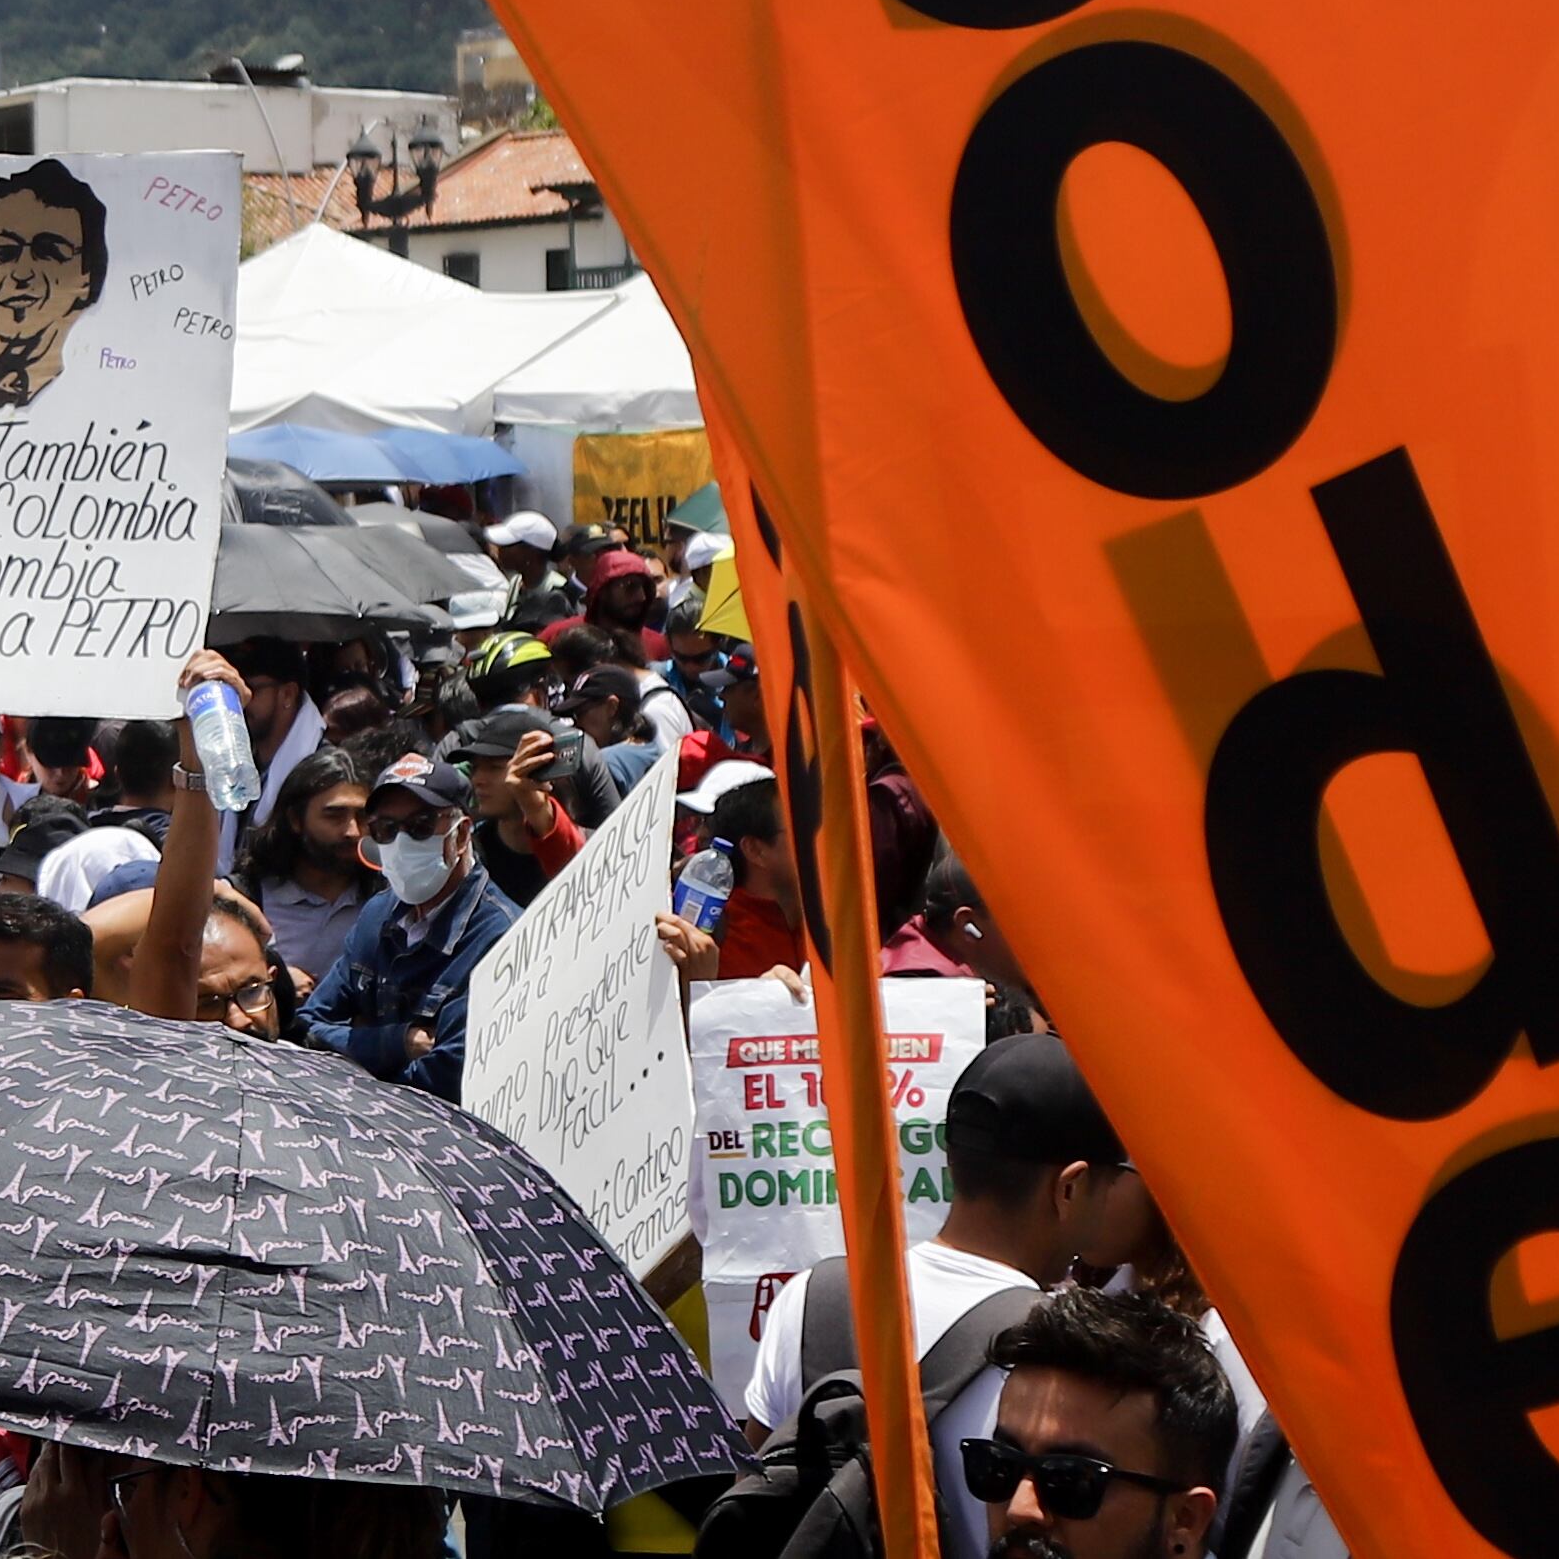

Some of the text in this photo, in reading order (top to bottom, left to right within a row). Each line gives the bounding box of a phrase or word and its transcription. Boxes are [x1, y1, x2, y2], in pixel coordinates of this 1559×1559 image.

[144, 175, 223, 222] PETRO
[129, 264, 184, 302] PETRO
[173, 306, 233, 341] PETRO
[48, 598, 202, 660] PETRO
[573, 835, 652, 961] PETRO
[739, 1040, 786, 1063] QUE
[744, 1073, 786, 1110] EL
[708, 1130, 745, 1151] DEL
